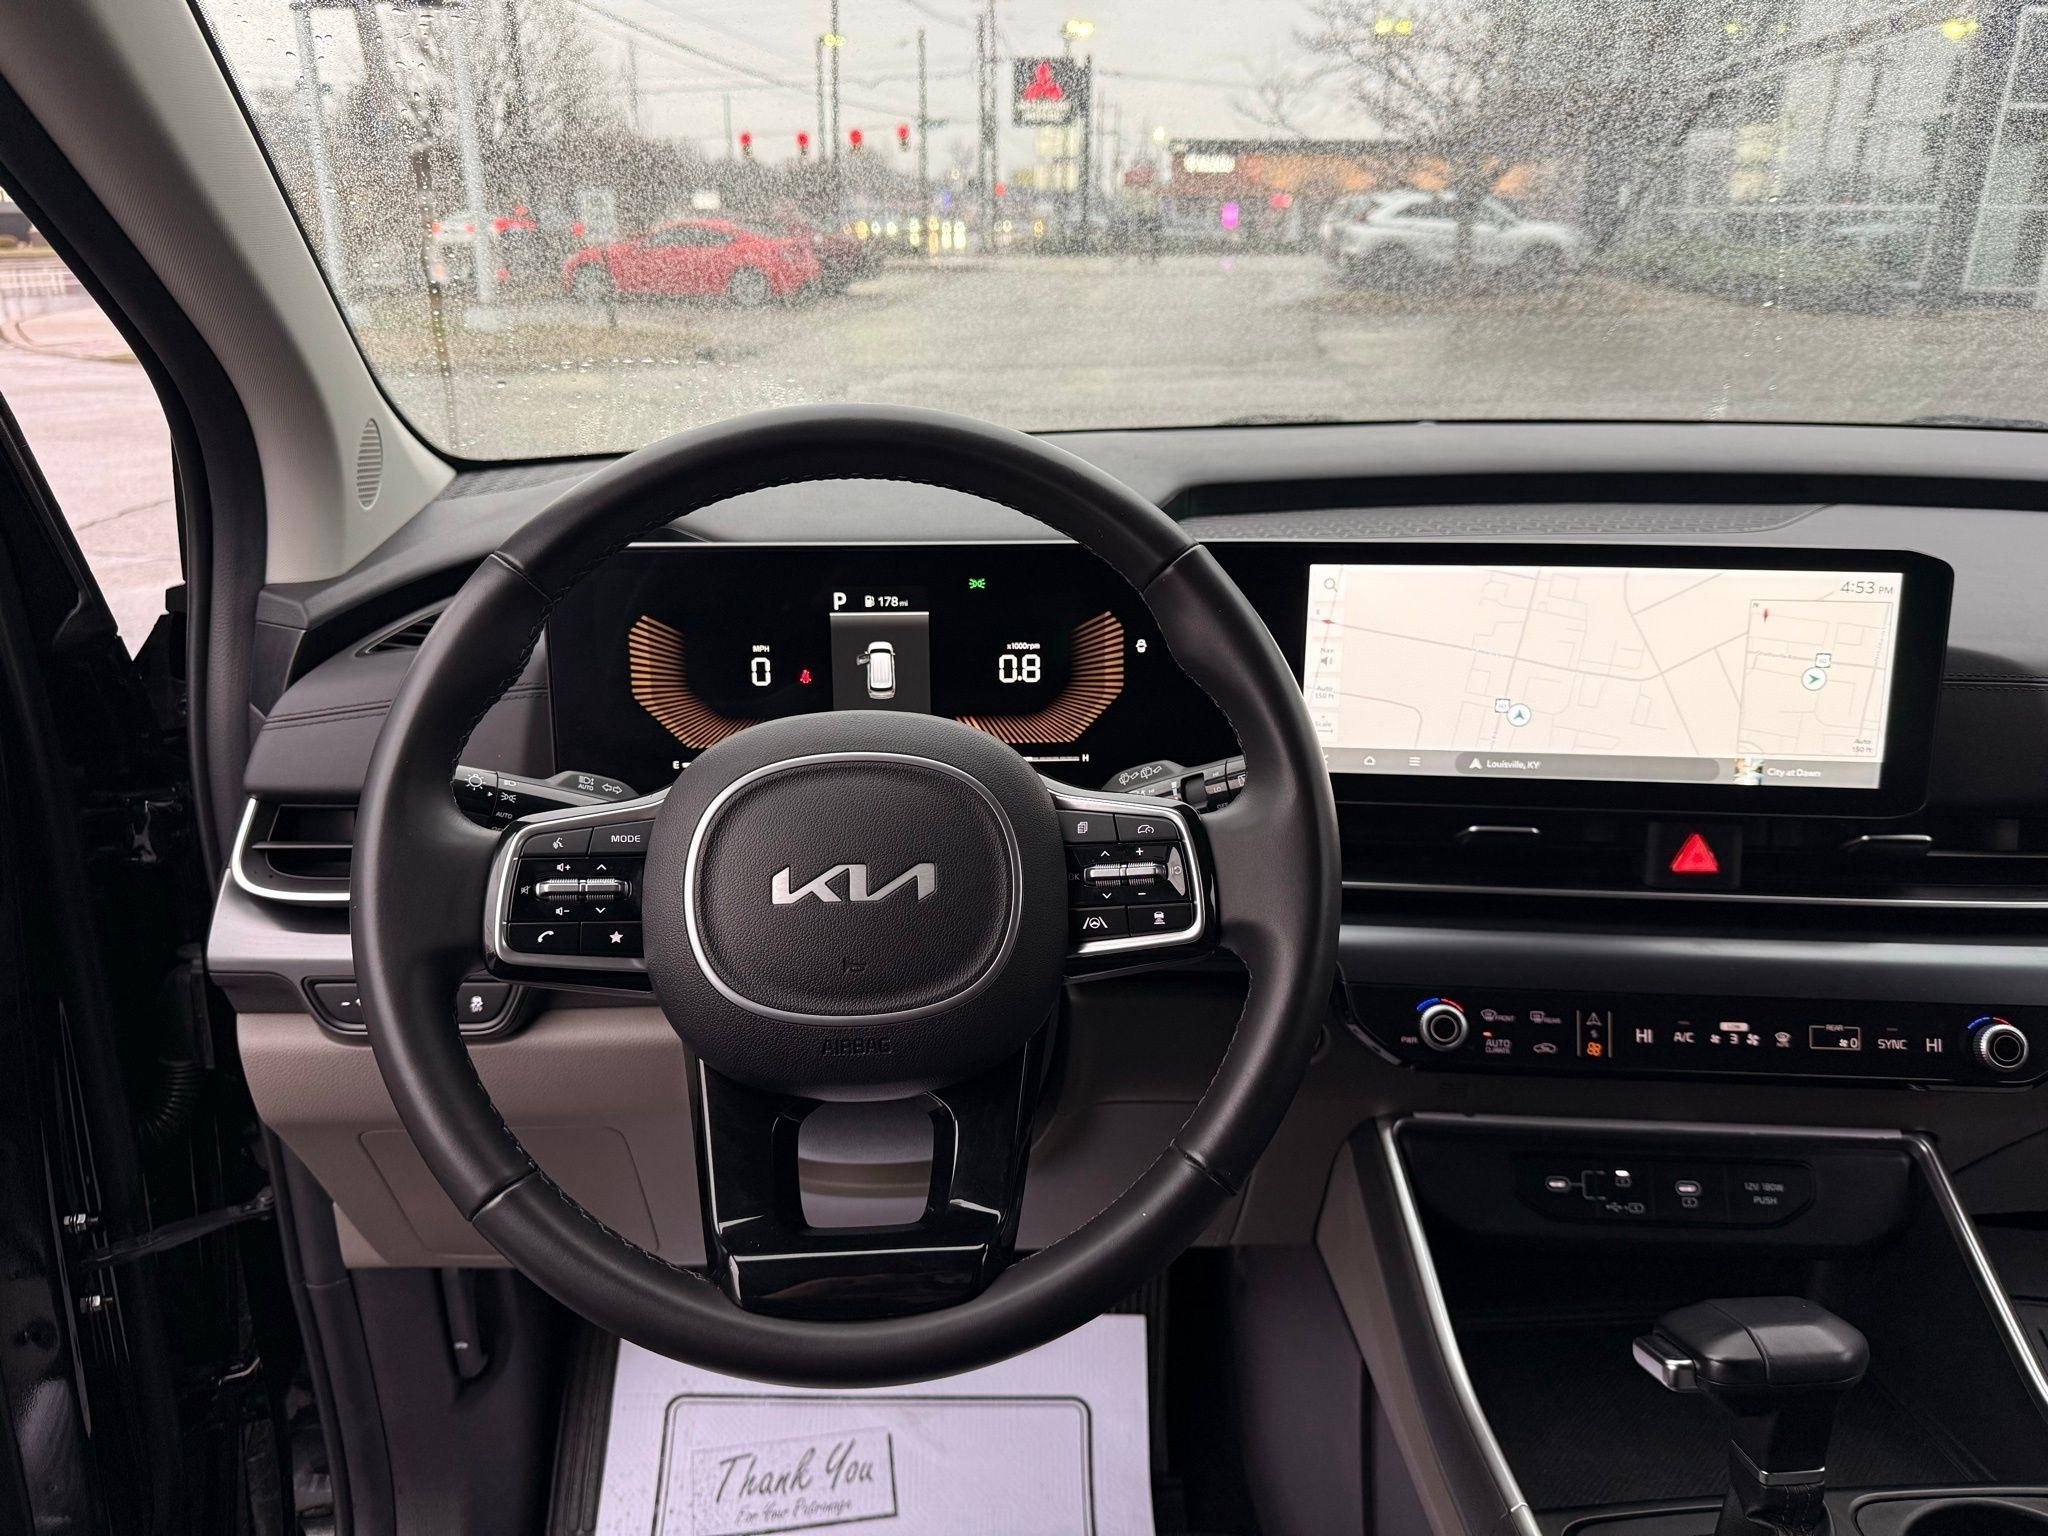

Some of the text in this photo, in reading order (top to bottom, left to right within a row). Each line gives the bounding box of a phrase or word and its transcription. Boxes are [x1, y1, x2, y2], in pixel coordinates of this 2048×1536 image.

[1840, 580, 1894, 595] 4:53 PM
[832, 591, 847, 611] P
[752, 644, 770, 653] MPH
[1006, 641, 1041, 651] x1000rpm
[750, 656, 772, 687] 0
[998, 653, 1041, 683] 0.8
[1081, 753, 1090, 762] H
[672, 760, 680, 769] E
[1486, 759, 1540, 770] Louisville, KY
[1766, 767, 1822, 778] City at Dawn
[577, 783, 594, 792] AUTO
[495, 811, 513, 820] AUTO
[610, 834, 641, 844] MODE
[1825, 1024, 1845, 1032] REAR
[1635, 1028, 1653, 1044] HI
[1673, 1031, 1696, 1044] A/C
[1729, 1033, 1740, 1045] 3
[1485, 1038, 1511, 1048] AUTO
[1877, 1038, 1908, 1050] SYNC
[1925, 1037, 1943, 1053] HI
[1753, 1196, 1778, 1206] PUSH
[715, 1437, 873, 1504] Thank You
